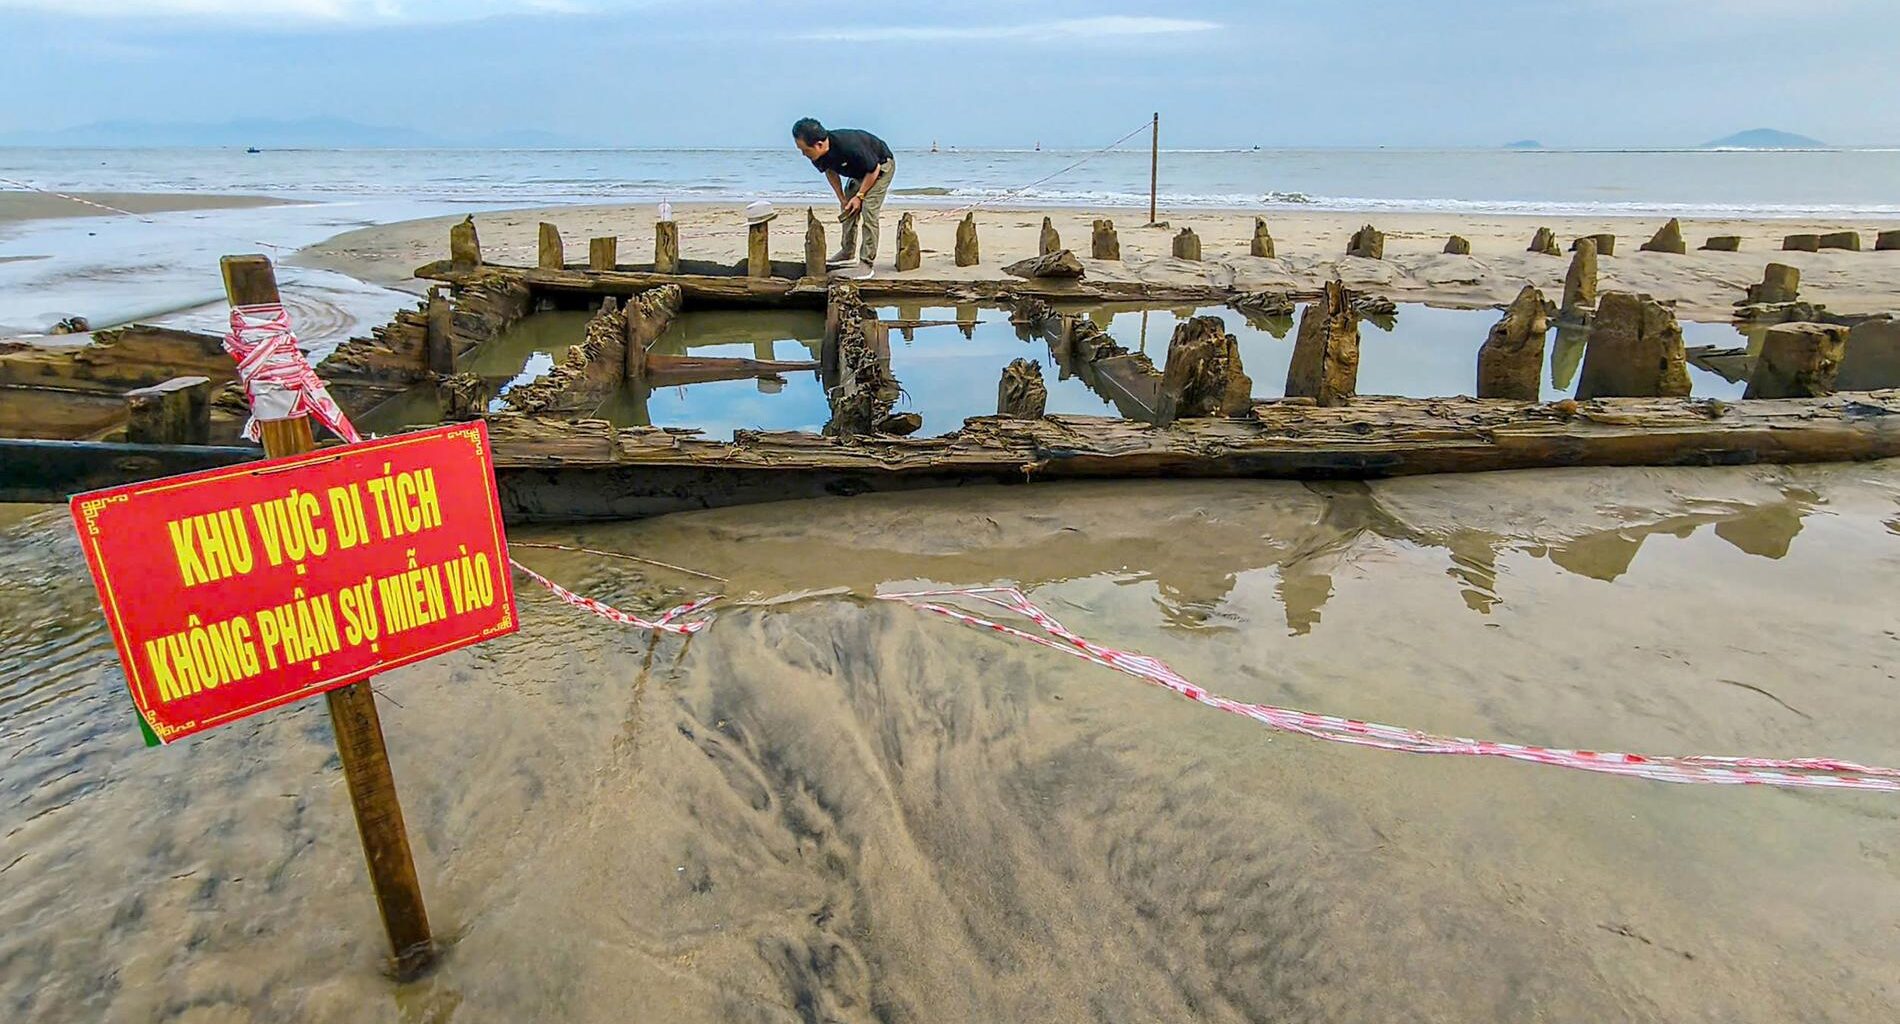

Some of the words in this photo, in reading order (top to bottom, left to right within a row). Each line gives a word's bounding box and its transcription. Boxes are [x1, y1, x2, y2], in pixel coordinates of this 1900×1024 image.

[169, 509, 253, 586] KHU
[253, 489, 327, 574] VỰC
[329, 484, 370, 549] DI
[368, 462, 442, 539] TÍCH
[146, 615, 260, 703] KHÔNG
[258, 588, 340, 671] PHẬN
[340, 576, 379, 652] SỰ
[379, 550, 446, 634] MIỄN
[446, 546, 494, 614] VÀO
